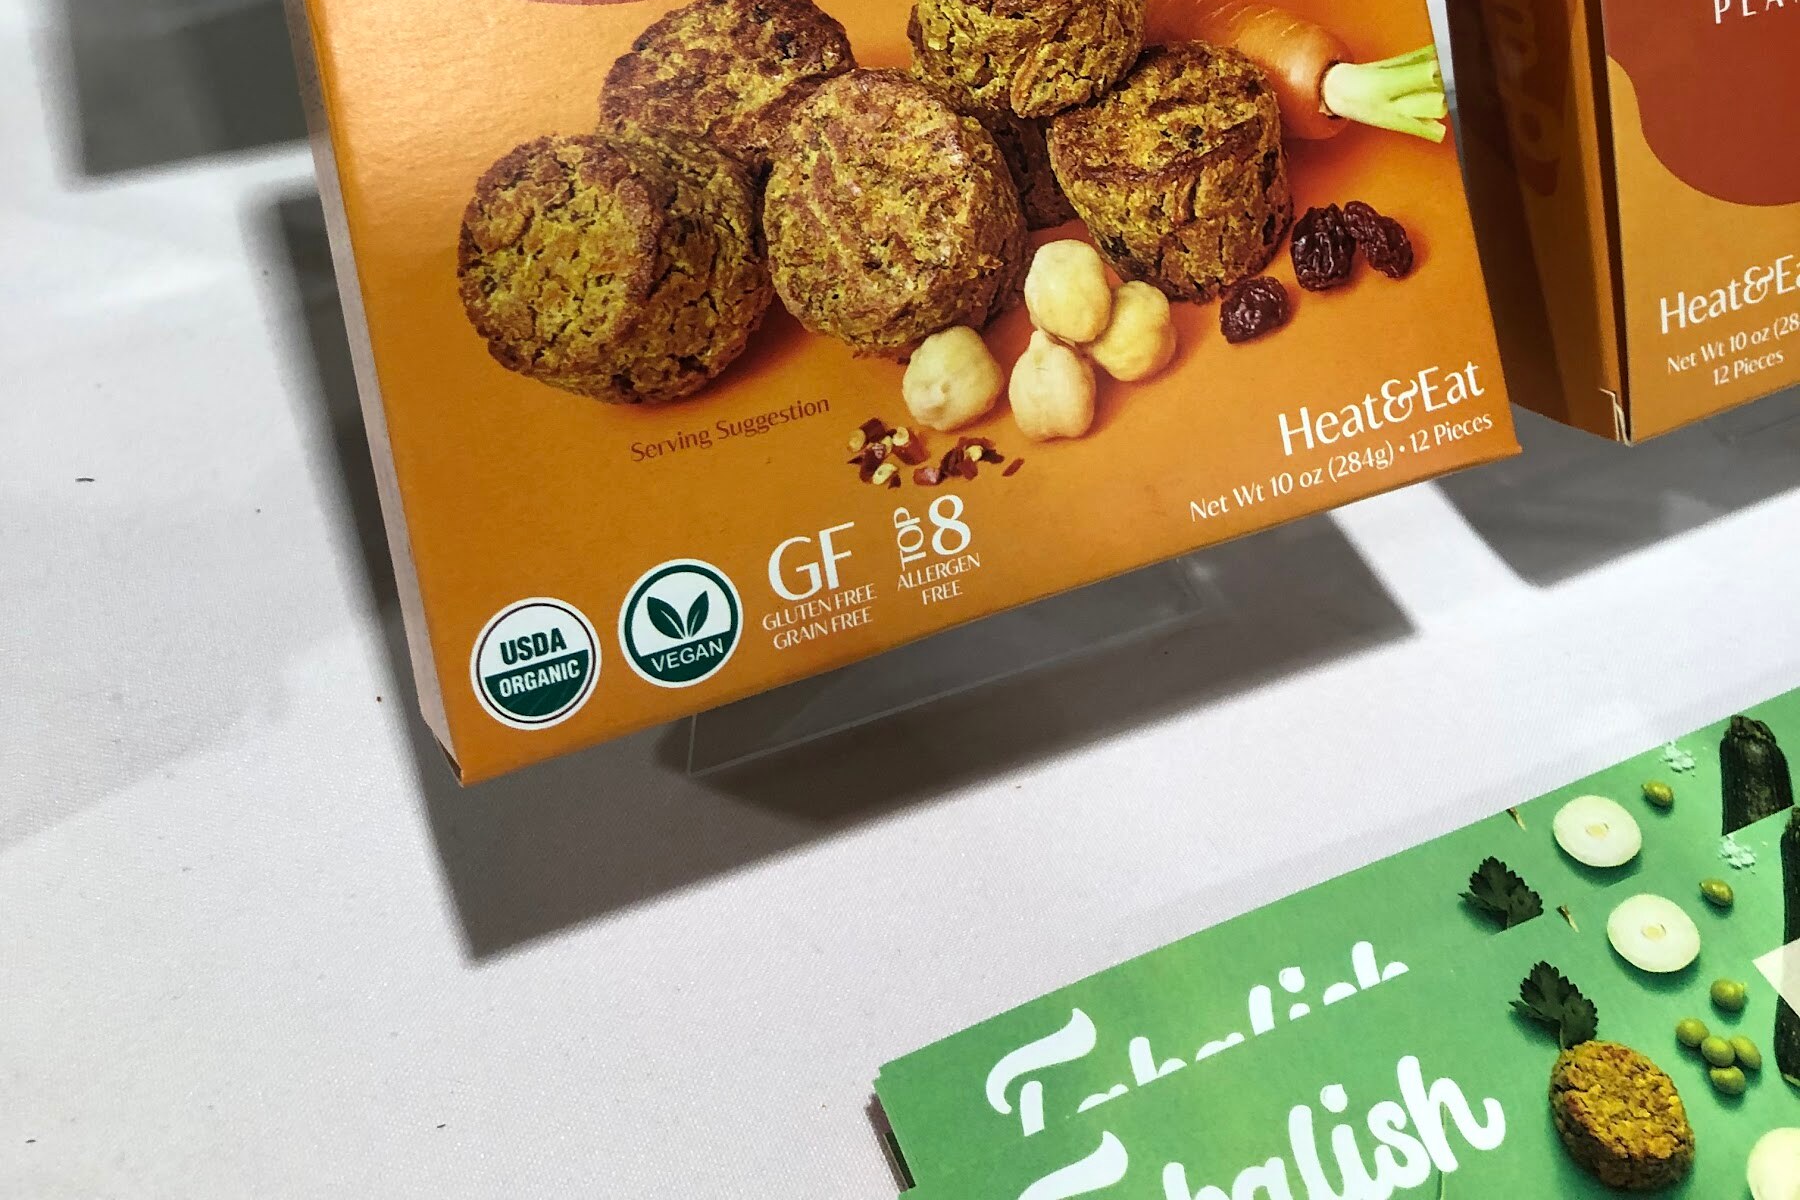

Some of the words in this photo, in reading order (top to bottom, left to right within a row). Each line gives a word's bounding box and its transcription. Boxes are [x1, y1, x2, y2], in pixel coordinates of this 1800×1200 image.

[1659, 254, 1800, 335] Heat&E
[1667, 352, 1697, 375] Net
[1700, 340, 1725, 362] Wt
[1730, 331, 1747, 353] 10
[1751, 327, 1770, 345] oz
[1773, 312, 1800, 340] (28
[1713, 365, 1729, 386] 12
[1733, 350, 1785, 379] Pieces
[630, 431, 713, 464] Serving
[716, 398, 831, 442] Suggestion
[1277, 360, 1486, 456] Heat&Eat
[1189, 494, 1230, 523] Net
[1232, 481, 1266, 510] Wt
[1270, 471, 1294, 499] 10
[1299, 467, 1325, 488] oz
[1328, 439, 1395, 484] (284g)
[1410, 429, 1431, 454] 12
[1434, 413, 1494, 447] Pieces
[893, 506, 927, 571] TOP
[928, 494, 972, 557] 8
[768, 521, 856, 601] GF
[897, 552, 982, 592] ALLERGEN
[762, 596, 832, 631] GLUTEN
[834, 583, 878, 610] FREE
[922, 579, 964, 606] FREE
[500, 627, 567, 666] USDA
[773, 616, 829, 650] GRAIN
[831, 605, 874, 633] FREE
[499, 659, 581, 698] ORGANIC
[651, 638, 724, 673] VEGAN
